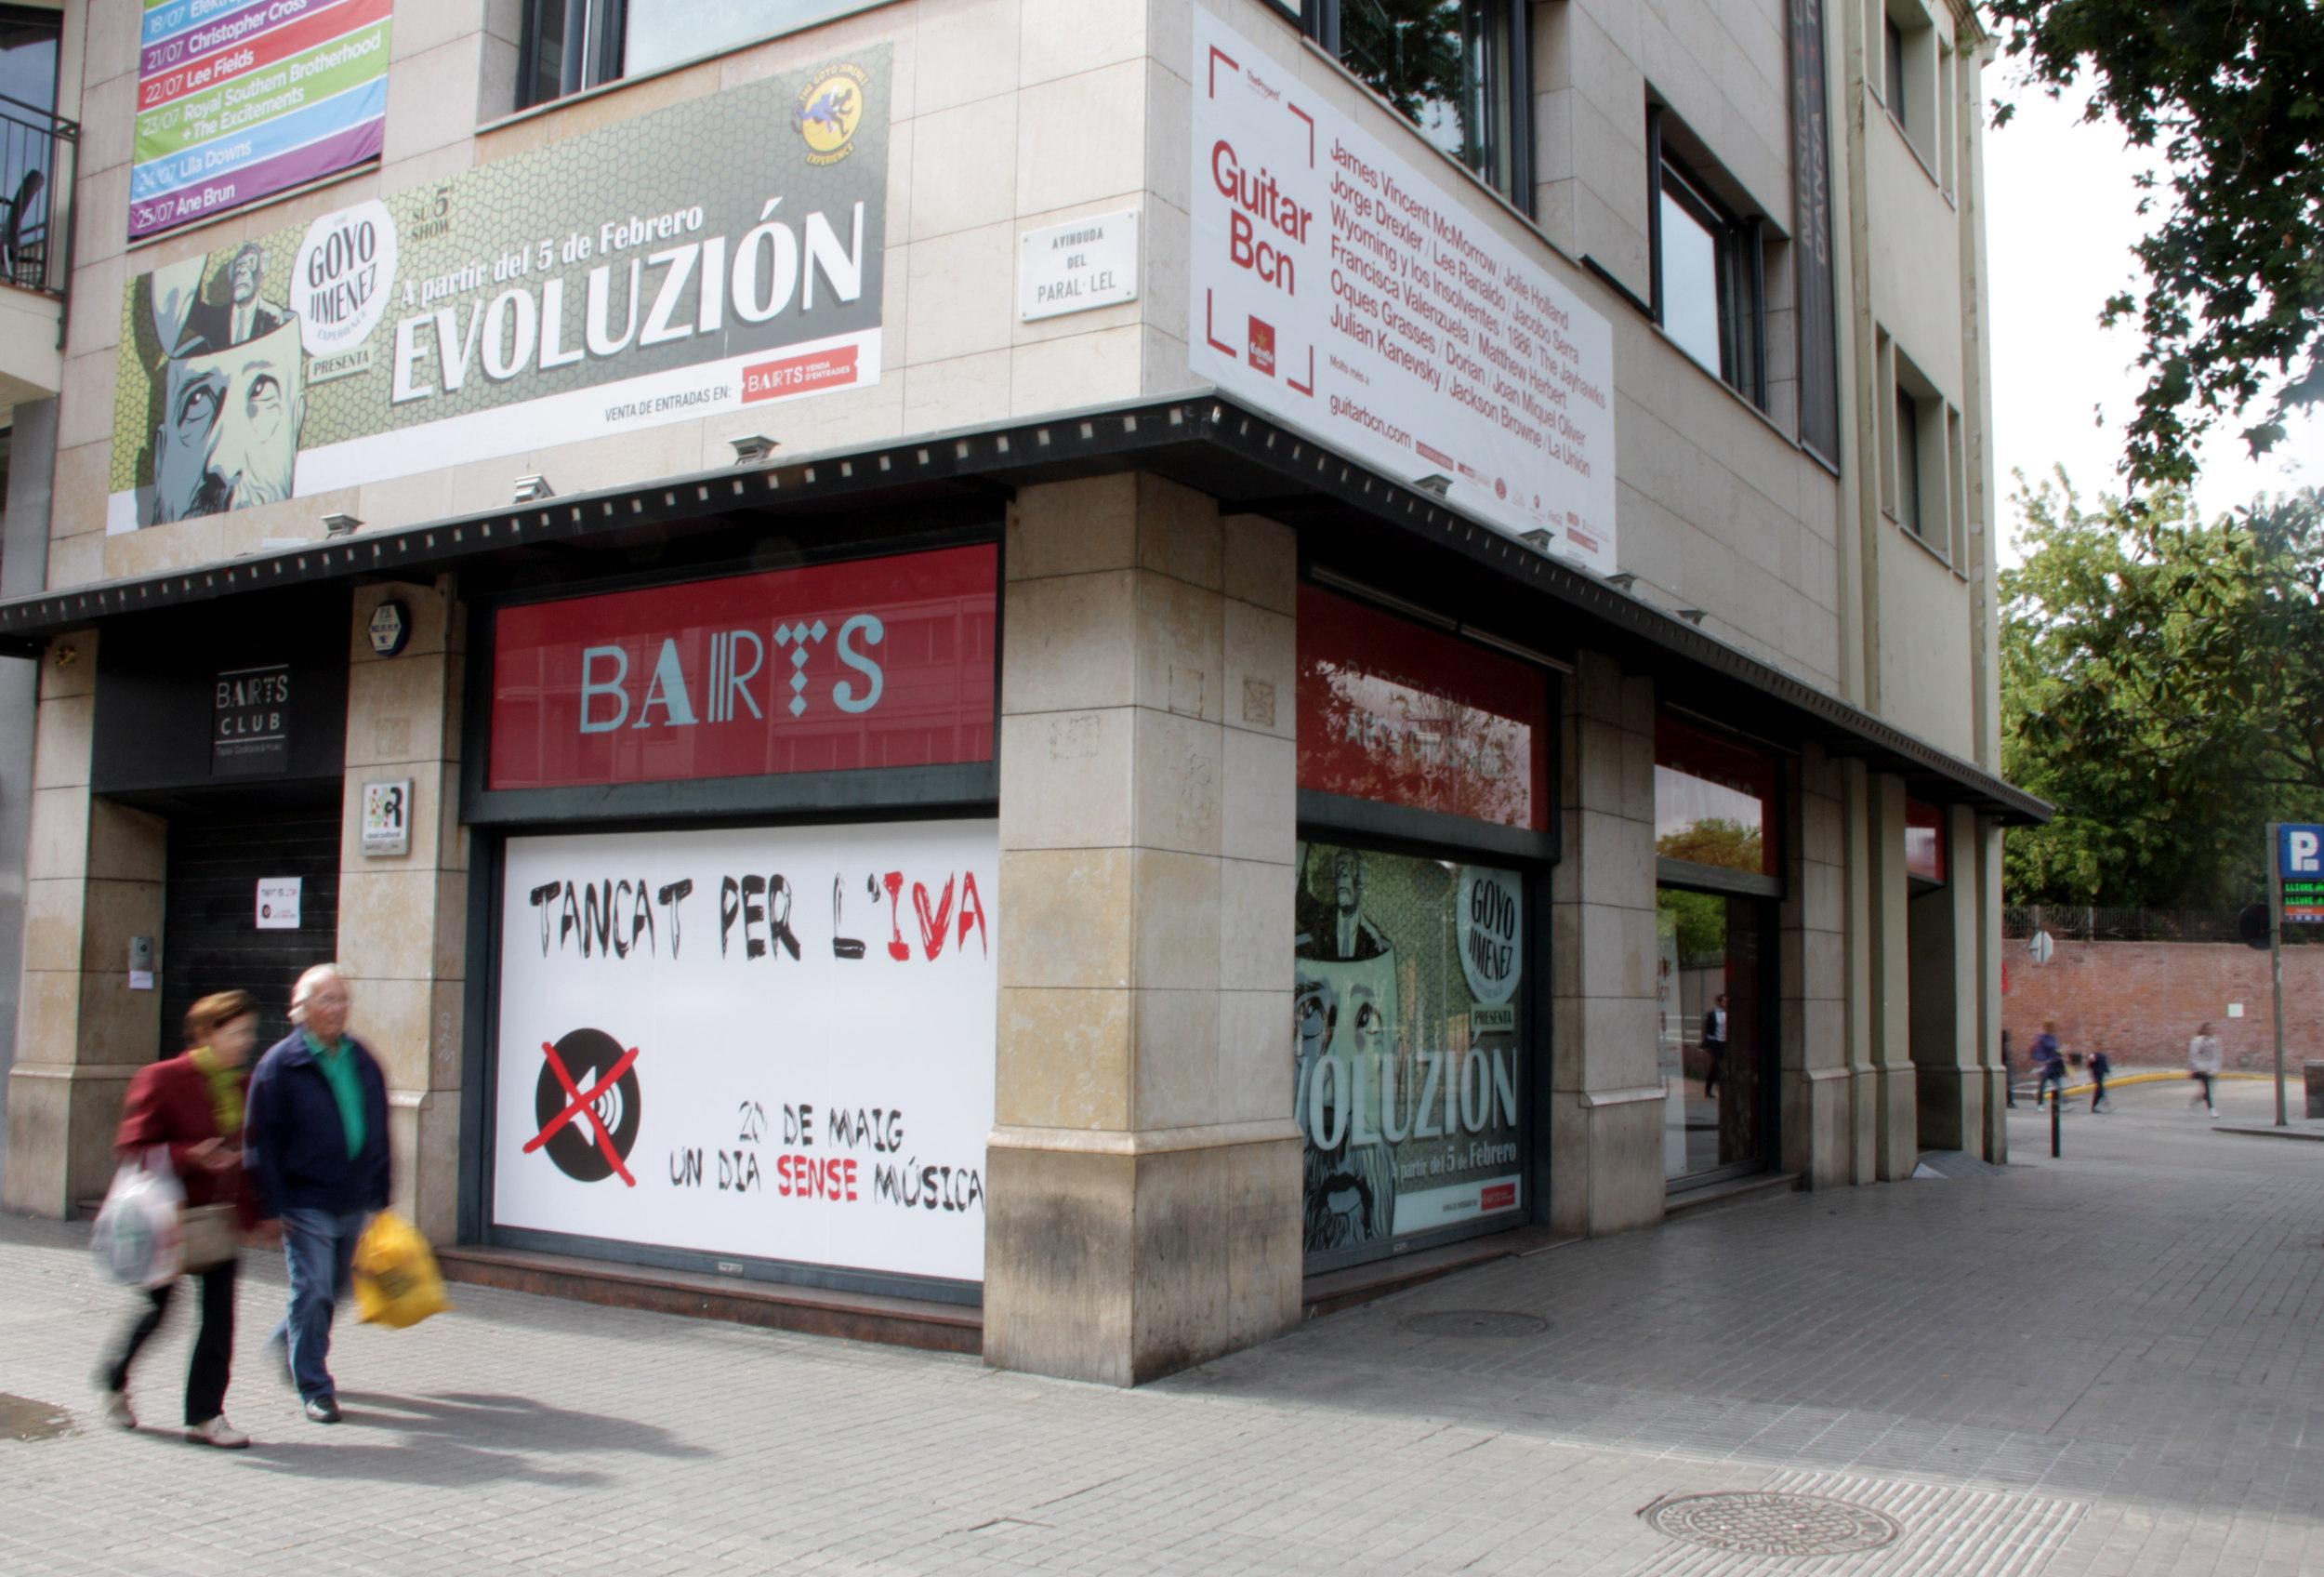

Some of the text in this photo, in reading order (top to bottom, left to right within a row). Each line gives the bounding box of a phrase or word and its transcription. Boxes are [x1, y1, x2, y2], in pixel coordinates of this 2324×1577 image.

[147, 0, 308, 70] 21/07 Christopher Cross
[150, 7, 185, 34] 18/07
[142, 30, 382, 137] 23/07 Royal Southern Brotherhood
[145, 48, 254, 103] 22/07 Lee Fields
[191, 117, 218, 139] The
[220, 87, 305, 131] Excitements
[179, 156, 202, 178] Lila
[205, 141, 252, 168] Downs
[137, 184, 235, 229] 25/07 Ane Brun
[1211, 139, 1313, 245] Guitar
[308, 220, 376, 288] GOYO
[401, 205, 704, 309] A partir del 5 de Febrero
[411, 219, 449, 243] SHOW
[1052, 227, 1103, 250] AVINGUDA
[1231, 207, 1295, 297] Bcn
[1330, 138, 1378, 189] James
[1381, 170, 1432, 229] Vincent
[1433, 211, 1498, 276] McMorrow
[1503, 266, 1529, 300] Jolie
[1531, 285, 1569, 331] Holland
[1067, 254, 1087, 270] DEL
[1330, 171, 1371, 217] Jorge
[1376, 199, 1423, 252] Drexler
[1433, 241, 1456, 275] Lee
[1459, 260, 1505, 311] Ranaldo
[1512, 301, 1551, 344] Jacobo
[1553, 328, 1579, 365] Serra
[390, 196, 865, 404] EVOLUZIÓN
[1330, 199, 1396, 272] Wyoming
[1400, 254, 1408, 278] y
[1411, 255, 1430, 288] los
[1433, 272, 1499, 337] Insolventes
[1538, 345, 1558, 377] The
[1561, 362, 1606, 409] Jayhawks
[1331, 234, 1399, 300] Francisca
[1403, 281, 1469, 346] Valenzuela
[1478, 332, 1526, 383] Matthew
[1529, 366, 1567, 410] Herbert
[313, 351, 369, 375] PRESENTA
[747, 365, 804, 392] BARTS
[1330, 303, 1373, 349] Julian
[1378, 329, 1442, 392] Kanevsky
[1449, 376, 1499, 423] Jackson
[1501, 405, 1542, 449] Browne
[1548, 434, 1562, 459] La
[1331, 269, 1378, 318] Oques
[1382, 300, 1436, 354] Grasses
[1446, 340, 1486, 386] Dorian
[1493, 373, 1521, 407] Joan
[1559, 414, 1587, 447] Oliver
[605, 404, 637, 421] VENTA
[640, 400, 653, 415] DE
[655, 389, 710, 412] ENTRADAS
[1330, 394, 1411, 449] guitarbcn.com
[217, 675, 288, 709] BARTS
[579, 614, 884, 735] BARTS
[221, 712, 280, 735] CLUB
[2291, 830, 2319, 871] P
[529, 870, 987, 961] TANCAT PER L'IVA
[1472, 879, 1514, 941] GOYO
[1474, 1010, 1512, 1026] PRESENTA
[739, 1100, 904, 1154] 20 DE MAIG
[669, 1145, 986, 1213] UN DIA SENSE MÚSICA
[1400, 1159, 1427, 1184] partir
[1430, 1154, 1445, 1175] del
[1446, 1146, 1456, 1172] 5
[1470, 1141, 1517, 1168] Febrero
